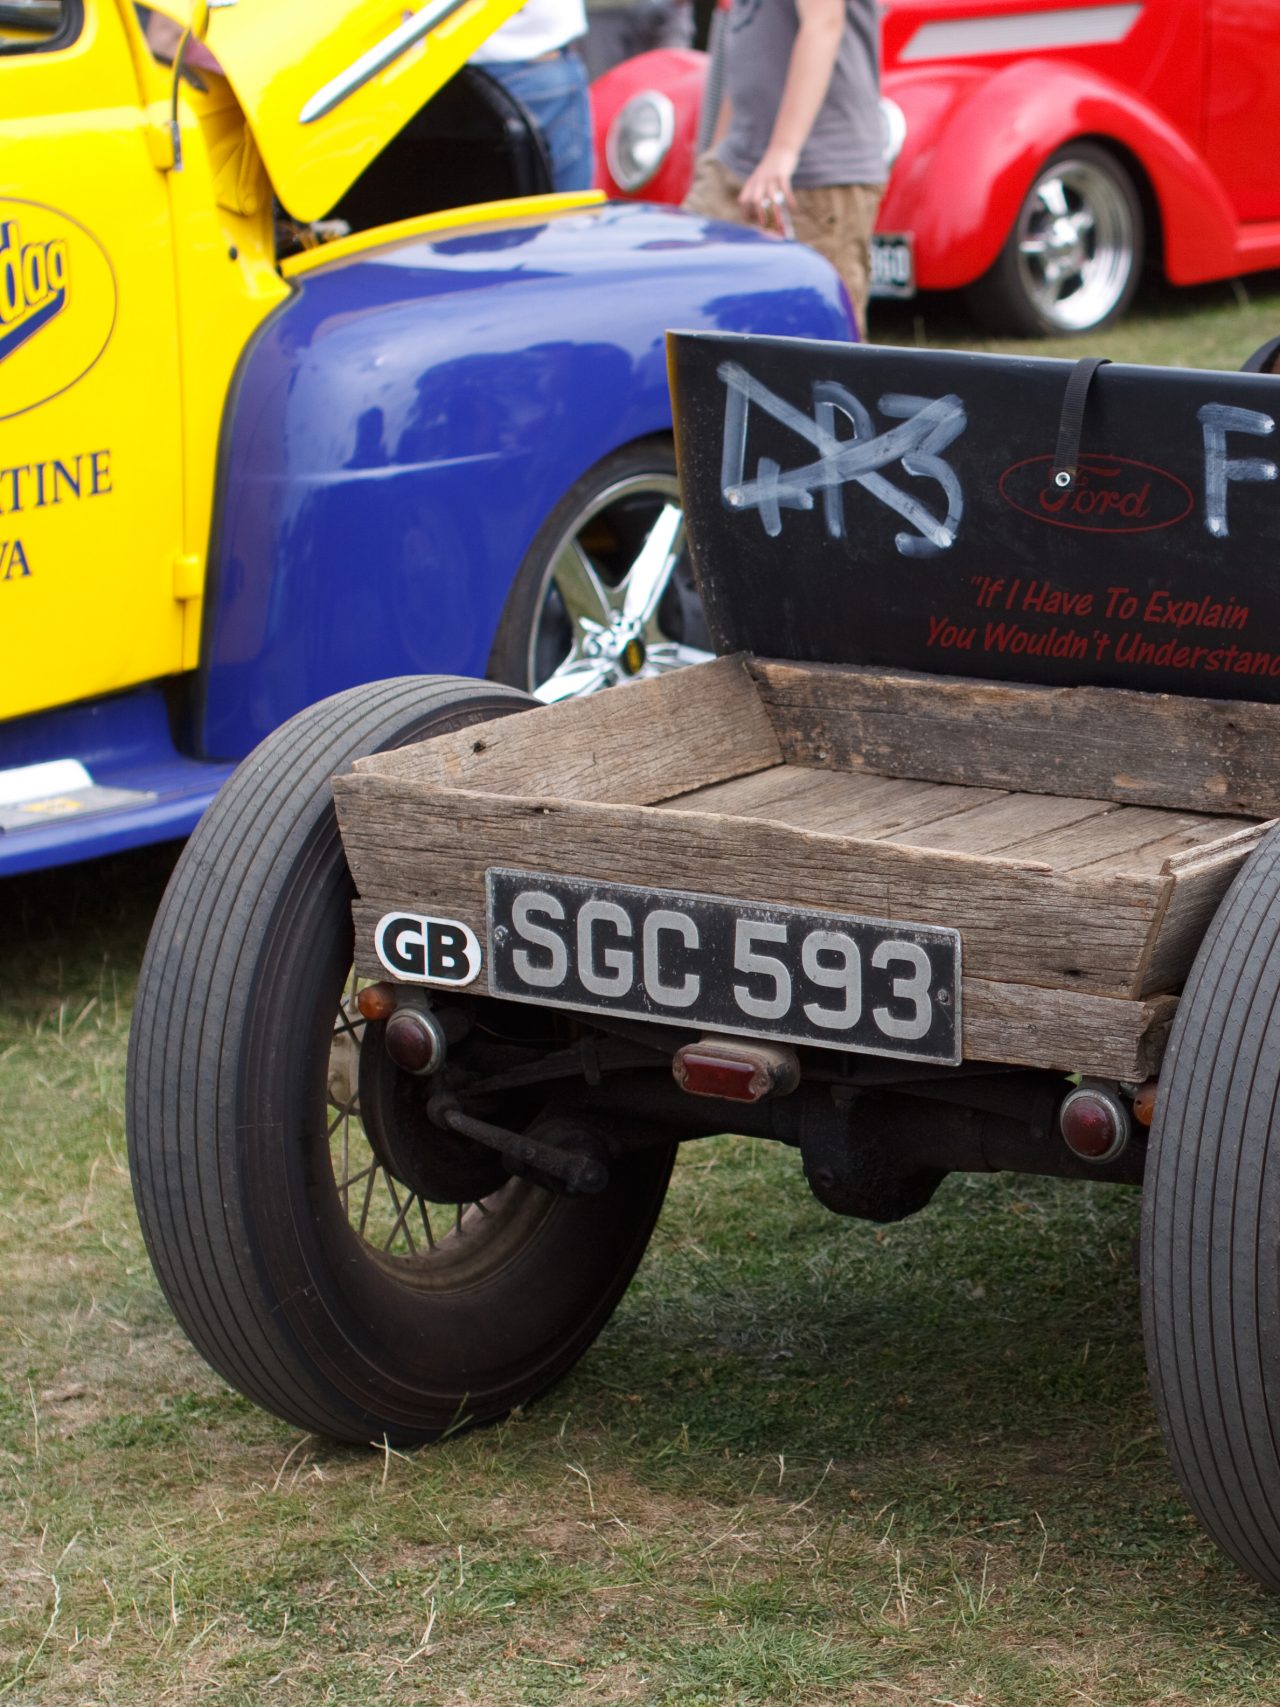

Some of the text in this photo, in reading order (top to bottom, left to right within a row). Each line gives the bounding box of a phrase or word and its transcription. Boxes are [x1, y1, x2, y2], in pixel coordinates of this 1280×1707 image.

[0, 448, 113, 515] TINE
[1005, 580, 1018, 609] I
[1022, 578, 1093, 618] Have
[1104, 586, 1139, 621] To
[1143, 589, 1250, 632] Explain
[925, 616, 976, 651] You
[984, 624, 1111, 664] Wouldn't
[382, 917, 471, 981] GB
[510, 890, 934, 1042] SGC 593
